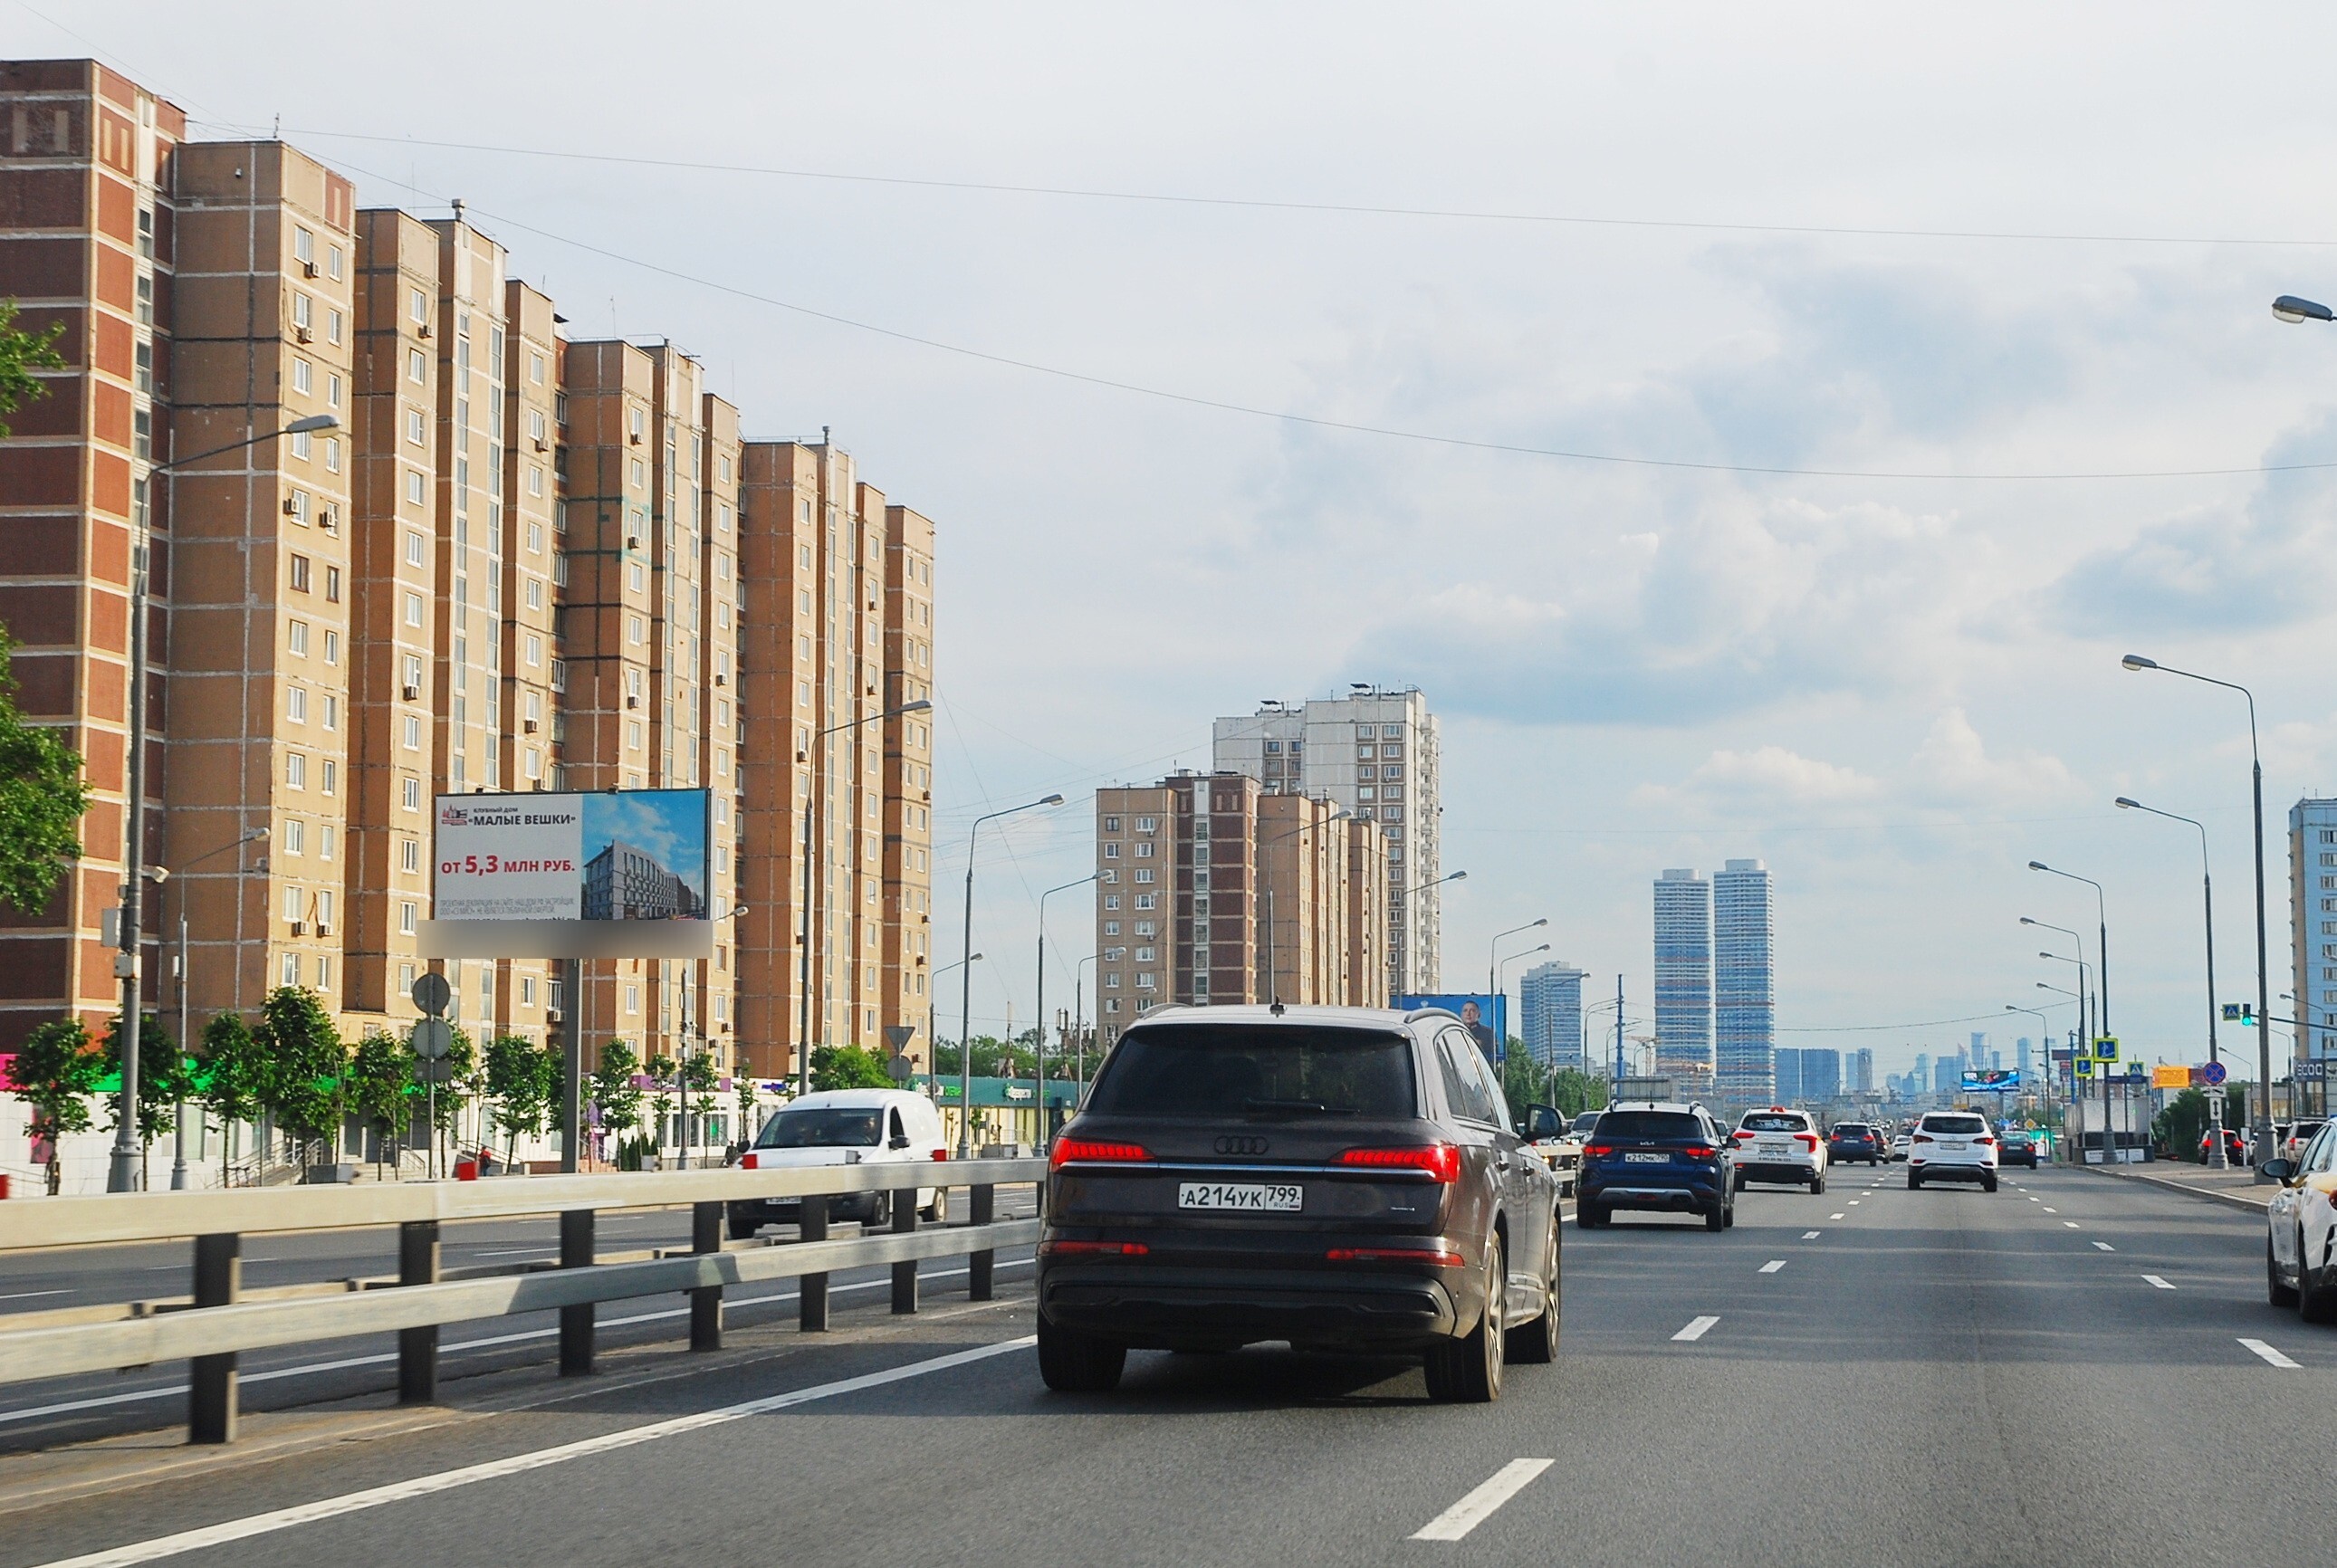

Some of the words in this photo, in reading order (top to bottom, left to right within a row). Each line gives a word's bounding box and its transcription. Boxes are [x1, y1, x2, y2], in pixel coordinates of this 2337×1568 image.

[468, 815, 522, 826] «МАЛЫЕ
[524, 814, 576, 825] ВЕШКИ»
[465, 855, 499, 876] 5,3
[503, 860, 539, 872] МЛН
[543, 860, 575, 872] РУБ.
[1268, 1187, 1298, 1202] 799
